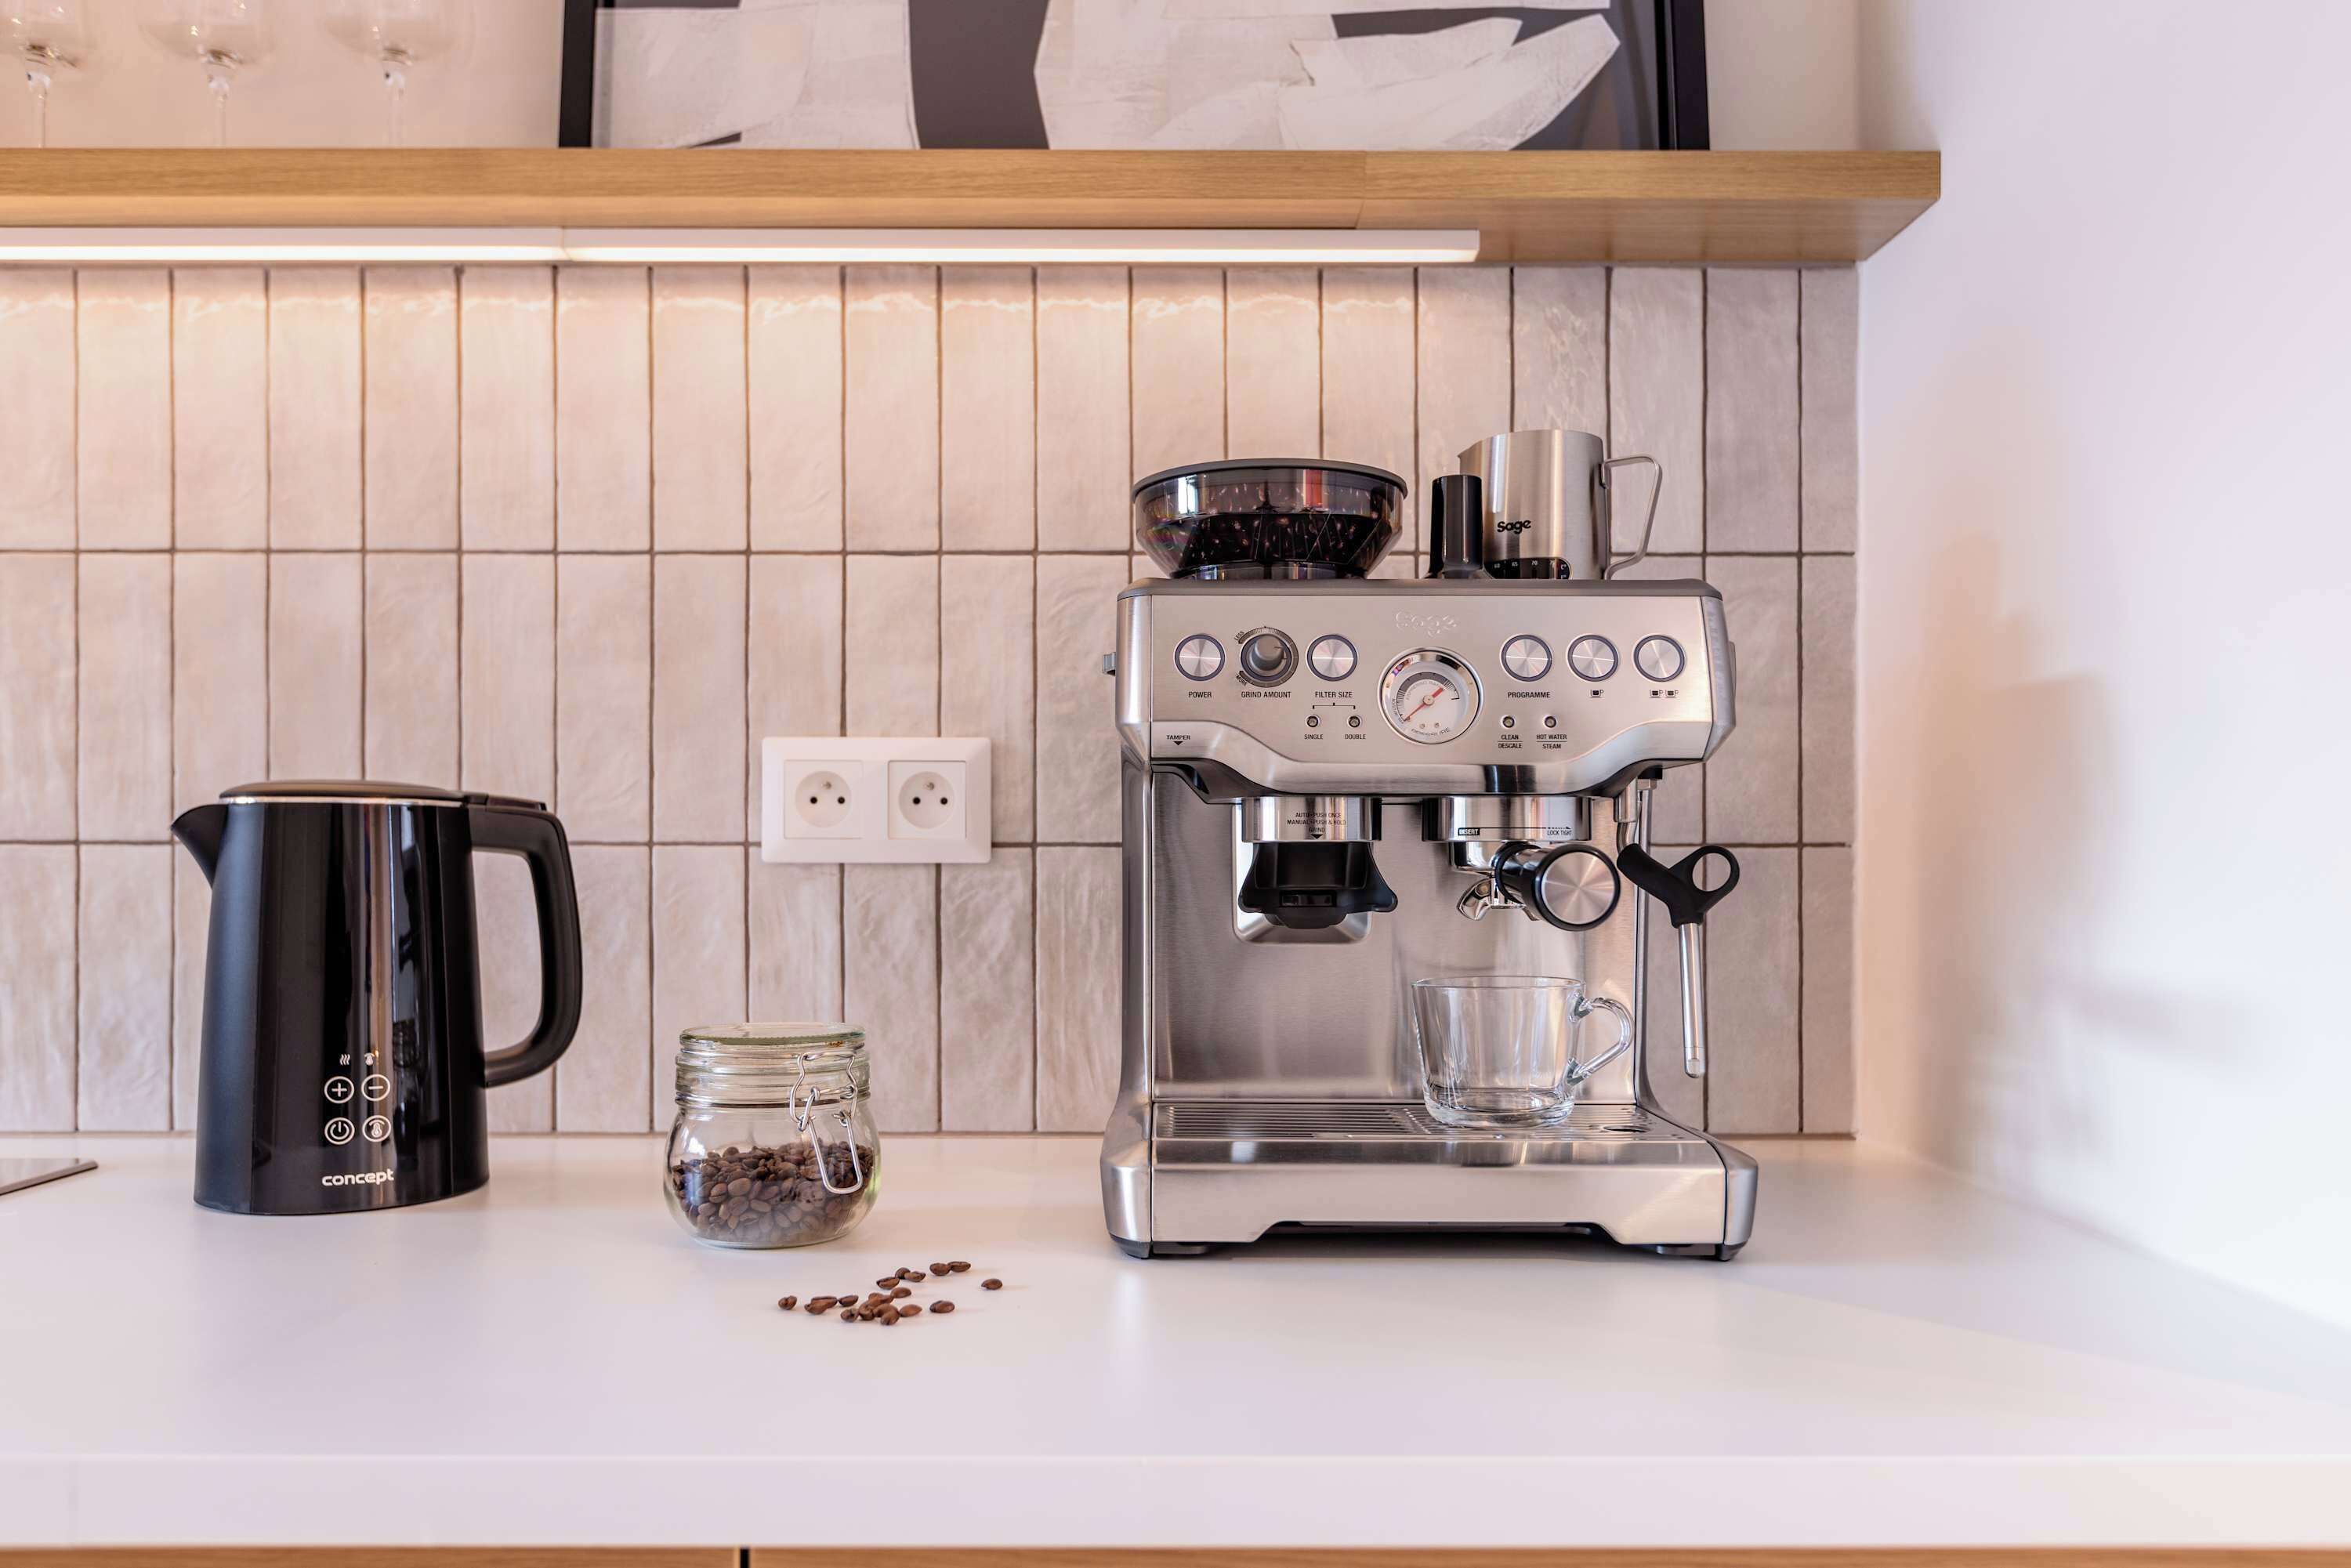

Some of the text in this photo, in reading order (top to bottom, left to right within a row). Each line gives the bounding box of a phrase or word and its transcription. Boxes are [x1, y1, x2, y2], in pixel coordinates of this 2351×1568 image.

[1233, 630, 1245, 642] LESS
[1235, 674, 1248, 686] MORE
[322, 1168, 394, 1186] concept
